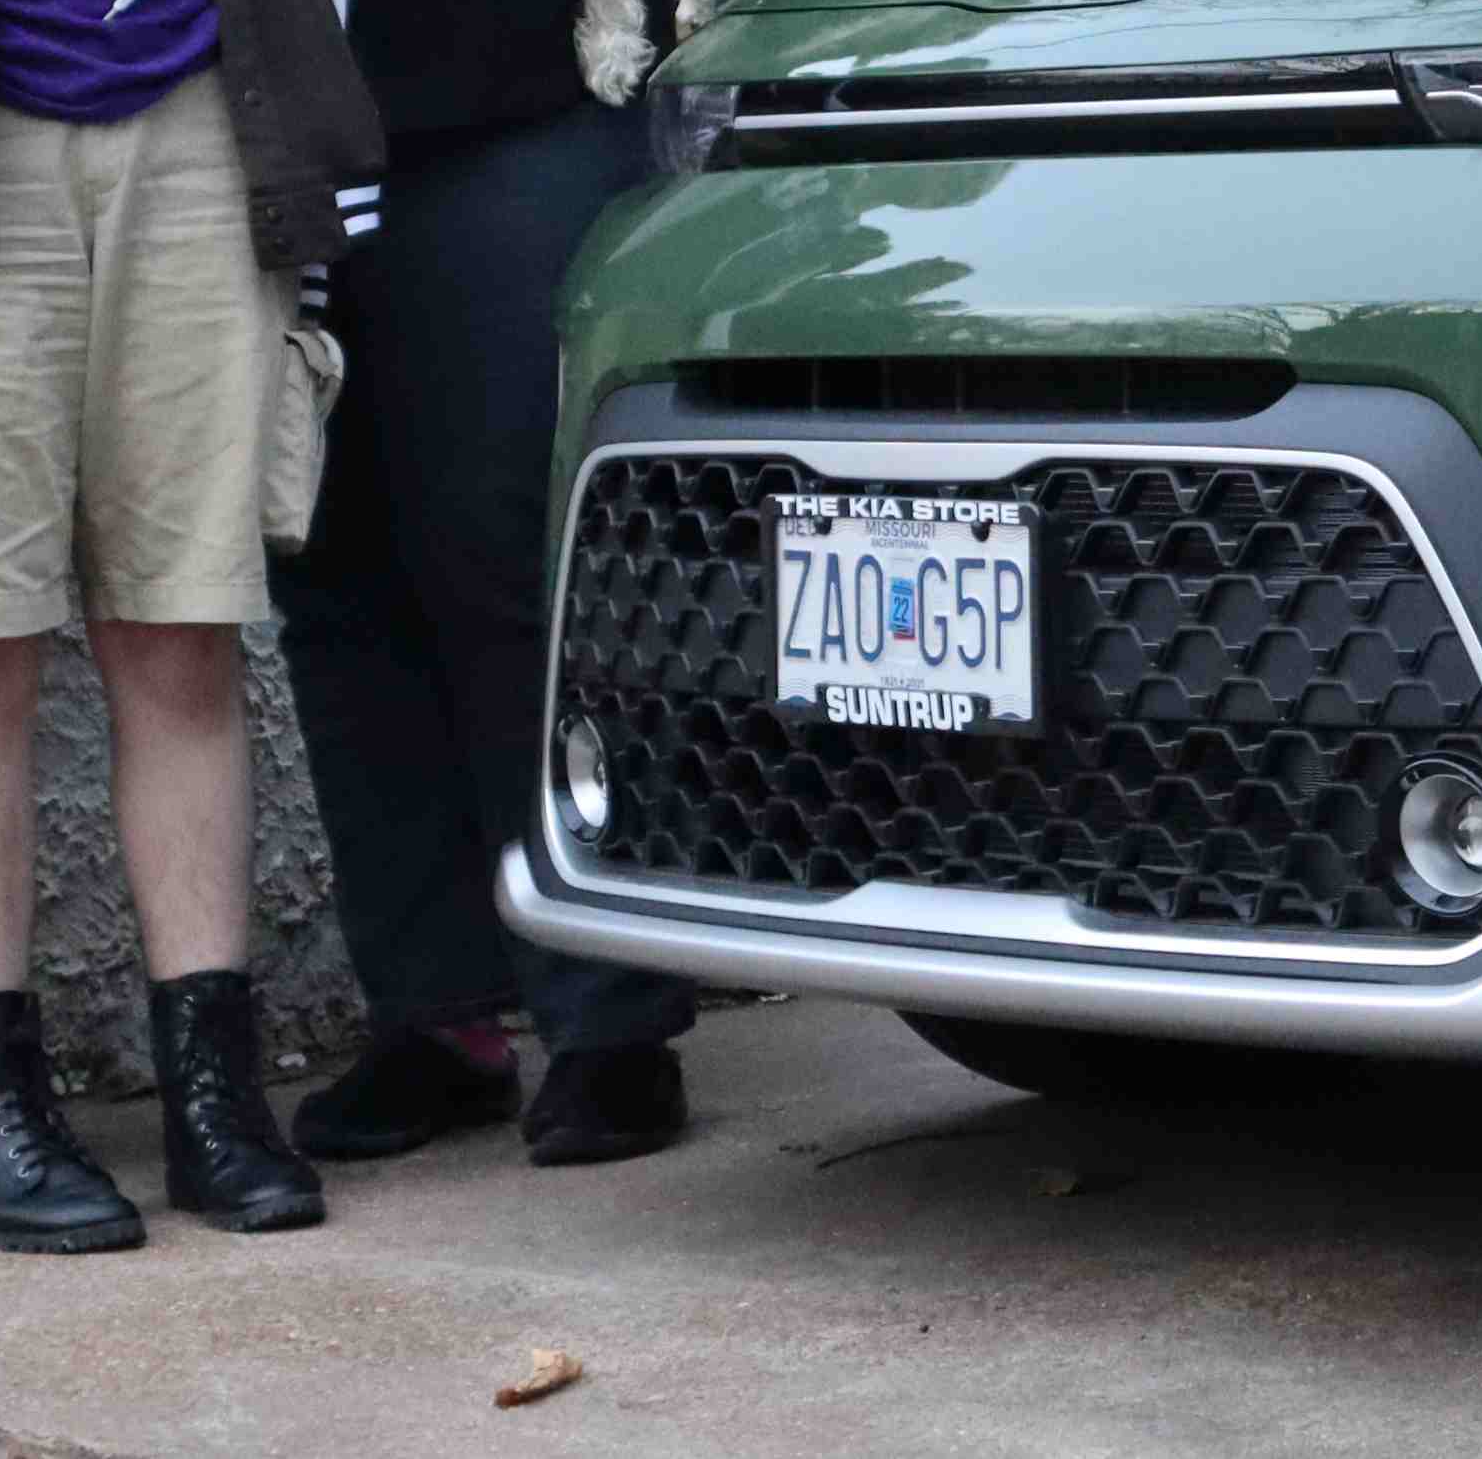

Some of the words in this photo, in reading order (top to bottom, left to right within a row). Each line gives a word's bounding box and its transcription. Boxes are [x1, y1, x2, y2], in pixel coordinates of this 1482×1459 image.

[774, 496, 838, 517] THE
[849, 498, 902, 520] KIA
[912, 500, 1020, 524] STORE
[867, 520, 935, 539] MISSOURI
[893, 597, 910, 622] 22
[825, 687, 974, 731] SUNTRUP
